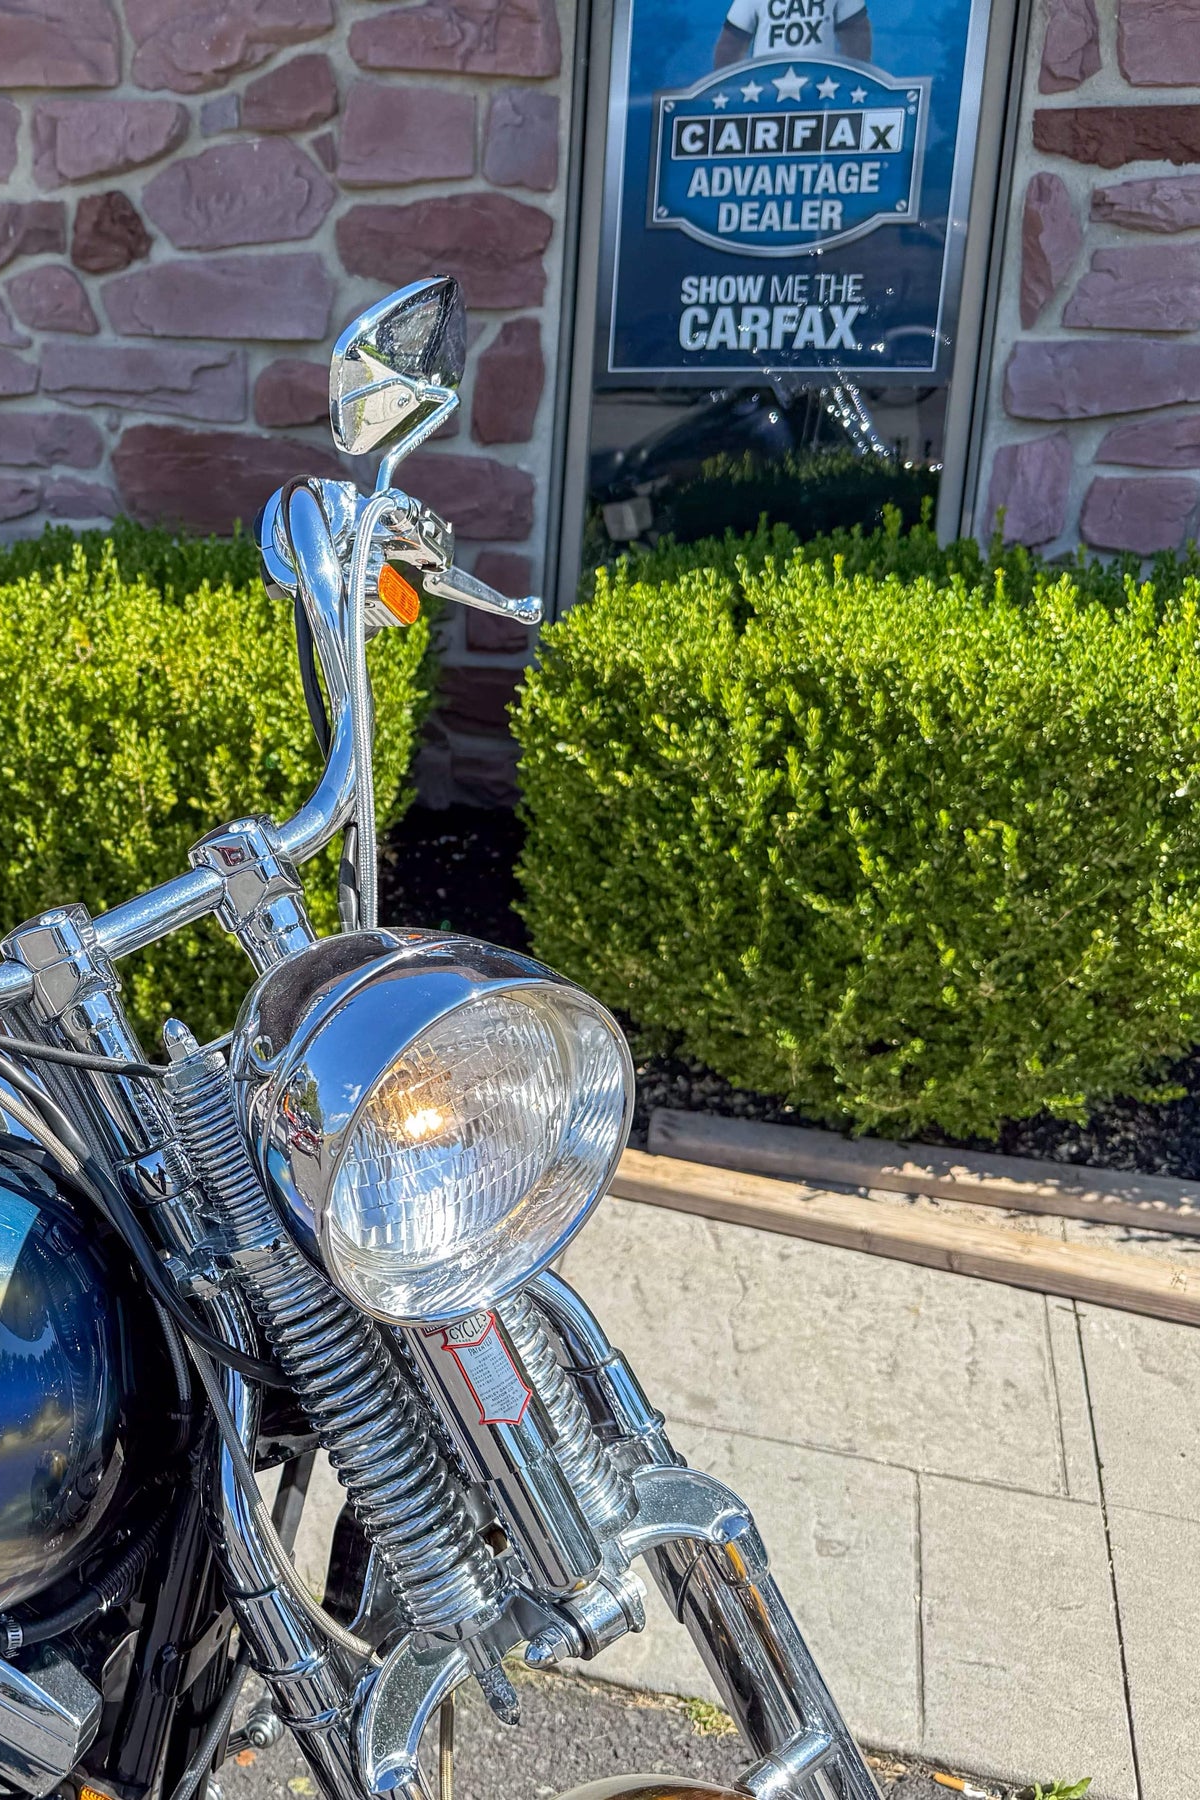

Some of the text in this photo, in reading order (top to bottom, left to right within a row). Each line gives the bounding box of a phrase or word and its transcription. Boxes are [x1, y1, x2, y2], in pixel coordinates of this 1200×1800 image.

[768, 0, 825, 20] CAR
[769, 20, 823, 48] FOX
[680, 117, 896, 153] CARFAX
[687, 161, 881, 198] ADVANTAGE
[717, 200, 844, 233] DEALER
[680, 273, 864, 304] SHOW ME THE
[679, 304, 860, 351] CARFAX
[449, 1313, 487, 1340] CYCLES
